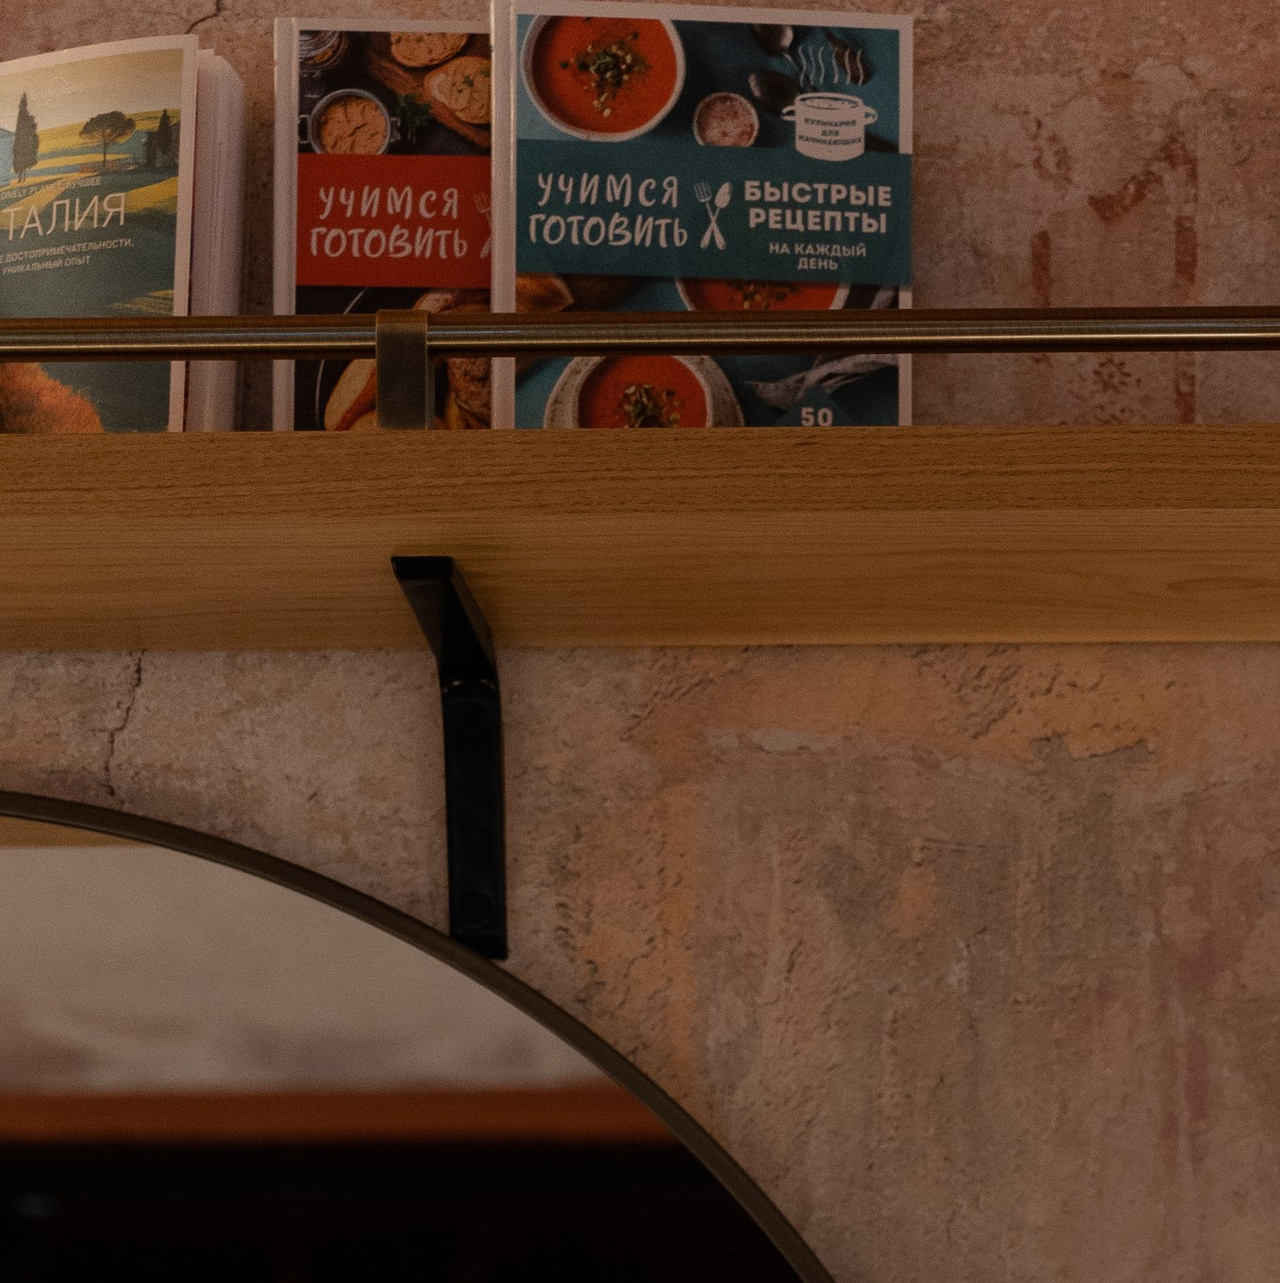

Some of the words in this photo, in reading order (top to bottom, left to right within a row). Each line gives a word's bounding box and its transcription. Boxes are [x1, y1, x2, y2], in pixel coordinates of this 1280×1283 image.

[318, 184, 460, 220] УЧИМСЯ
[537, 172, 679, 208] УЧИМСЯ
[744, 179, 892, 208] БЫСТРЫЕ
[2, 191, 127, 242] ТАЛИЯ
[529, 213, 688, 249] ГОТОВИТЬ
[748, 206, 887, 234] РЕЦЕПТЫ
[310, 226, 469, 260] ГОТОВИТЬ
[769, 242, 791, 256] НА
[795, 243, 867, 259] КАЖДЫЙ
[64, 255, 92, 268] ОПЫТ
[797, 256, 839, 271] ДЕНЬ
[800, 407, 833, 427] 50
